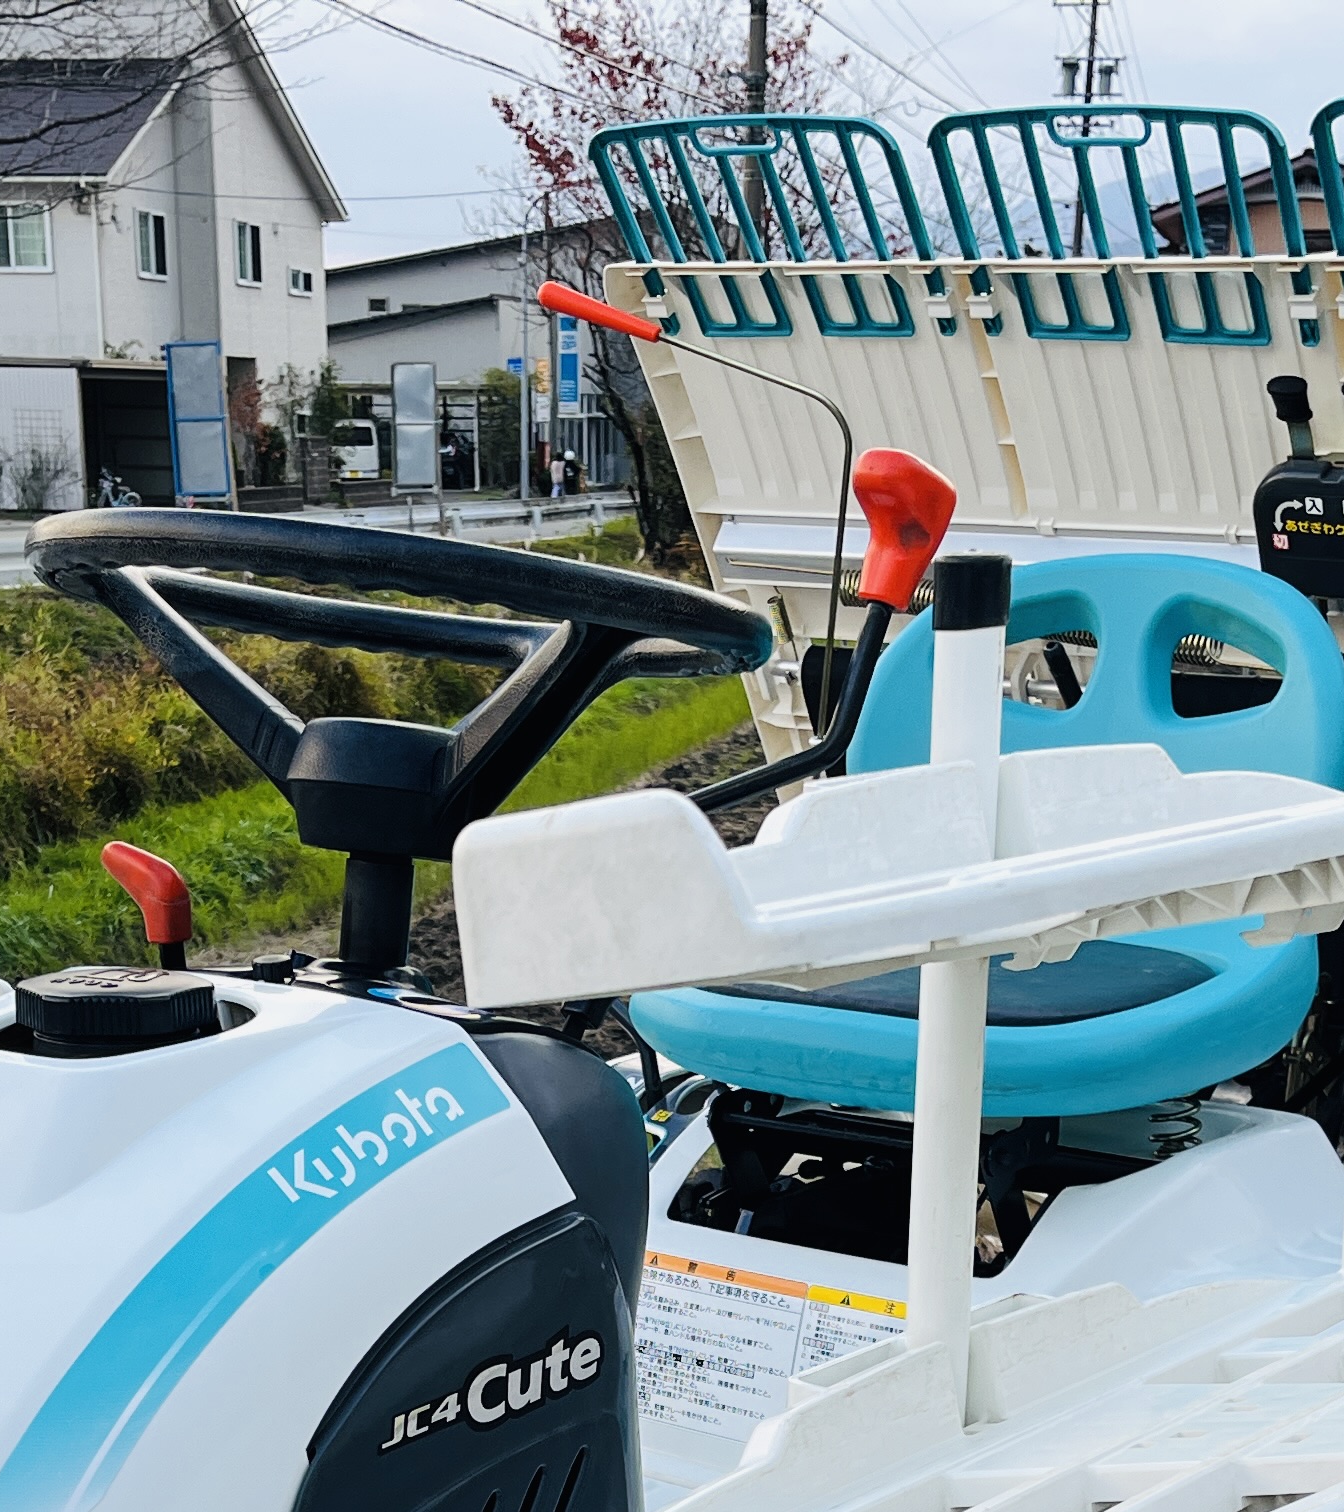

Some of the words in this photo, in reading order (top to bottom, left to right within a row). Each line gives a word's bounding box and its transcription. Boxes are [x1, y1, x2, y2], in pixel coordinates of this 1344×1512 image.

[1307, 499, 1323, 513] 入
[1273, 535, 1289, 549] 切
[267, 1087, 464, 1203] Kubota
[381, 1392, 461, 1449] JC4
[467, 1337, 601, 1424] Cute
